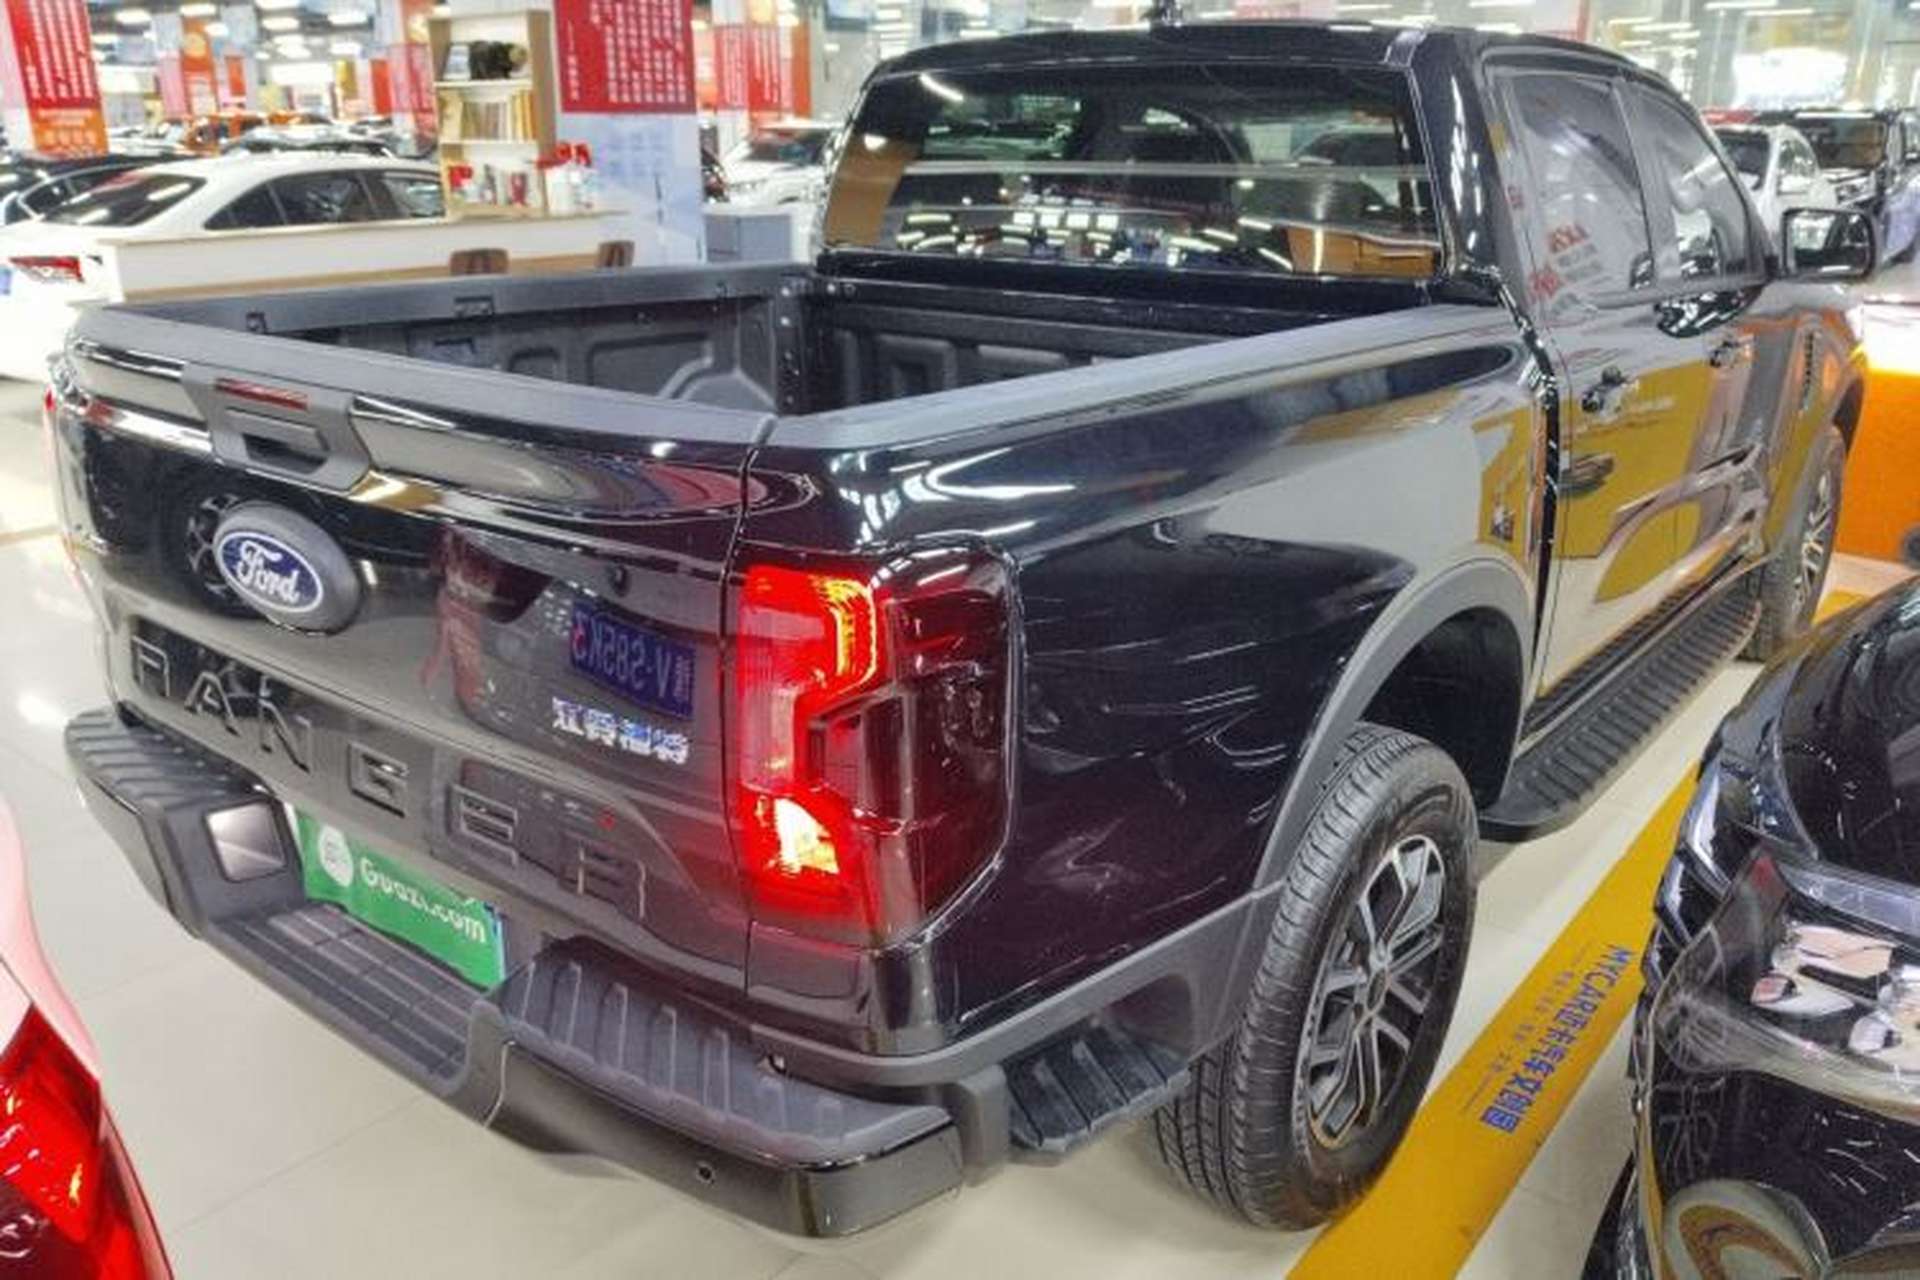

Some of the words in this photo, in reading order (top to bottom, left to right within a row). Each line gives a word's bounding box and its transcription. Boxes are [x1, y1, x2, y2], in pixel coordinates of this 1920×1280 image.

[236, 539, 300, 604] Ford
[132, 634, 648, 919] RANGER
[359, 856, 487, 943] Guazi.com
